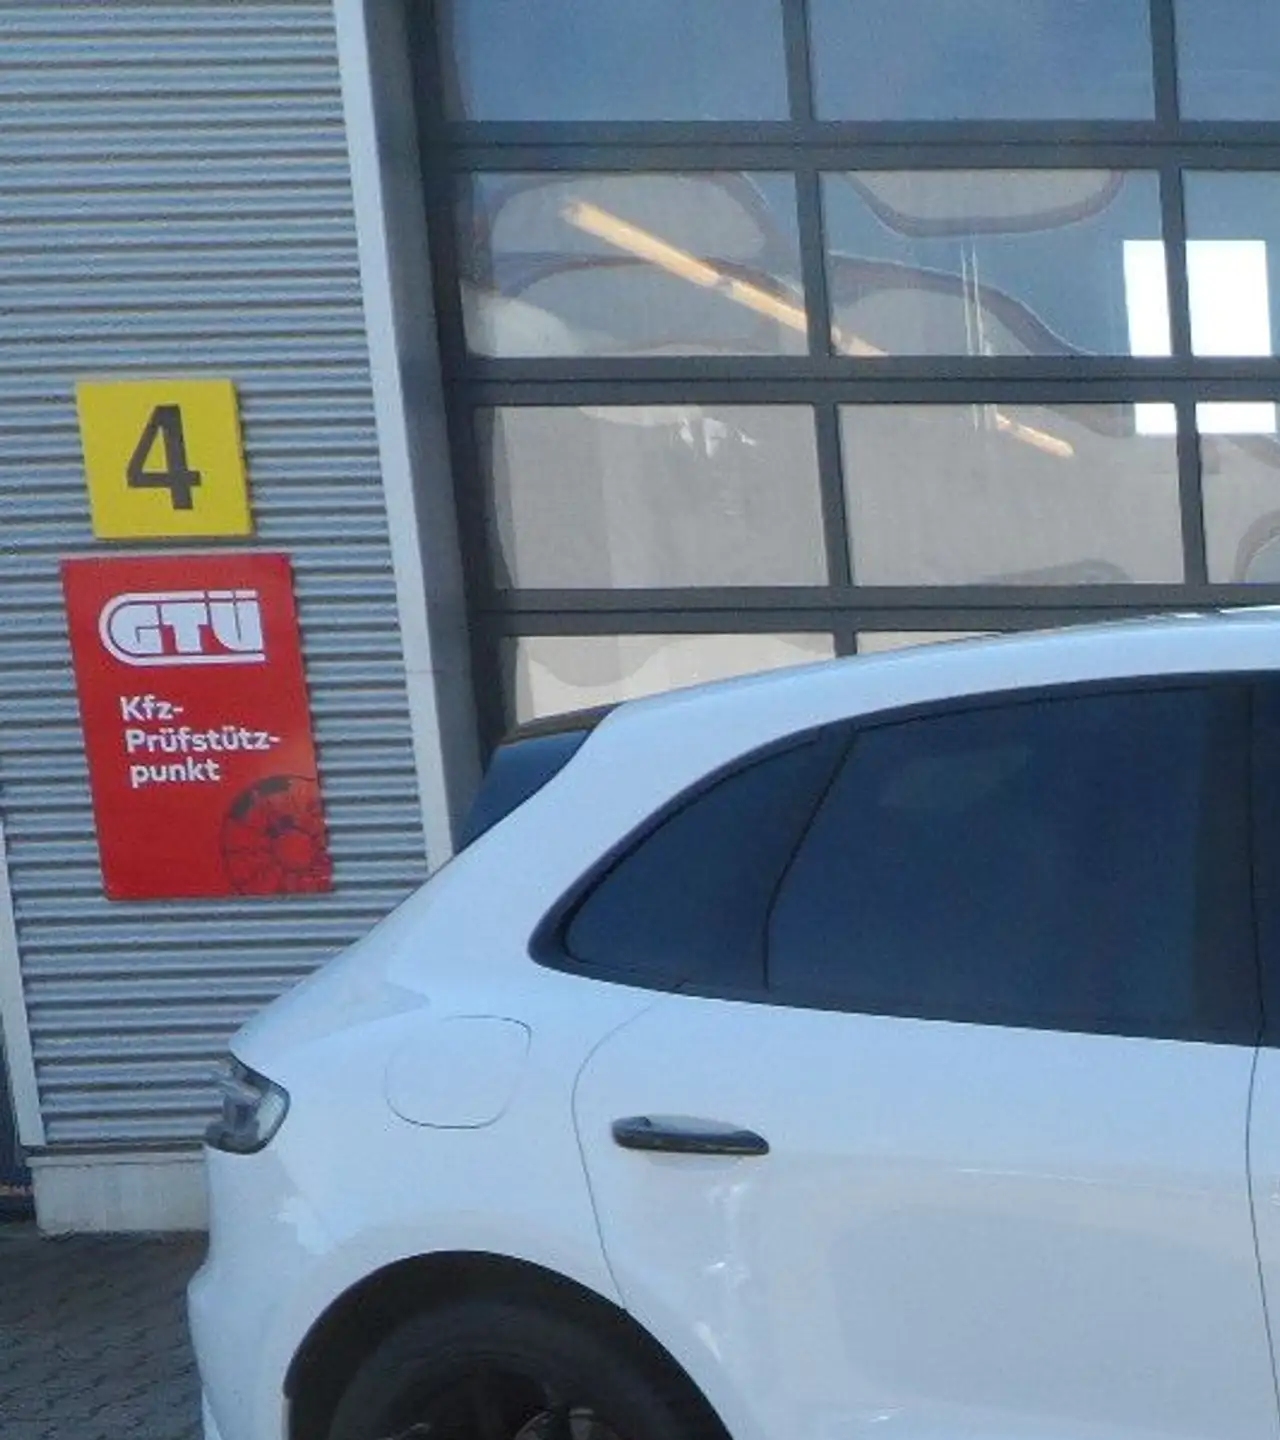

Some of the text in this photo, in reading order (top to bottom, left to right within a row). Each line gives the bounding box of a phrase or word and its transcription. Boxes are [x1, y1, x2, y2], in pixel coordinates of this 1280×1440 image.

[126, 403, 201, 511] 4
[119, 695, 184, 722] Kfz-
[125, 726, 281, 754] Prüfstütz-
[130, 757, 221, 789] punkt
